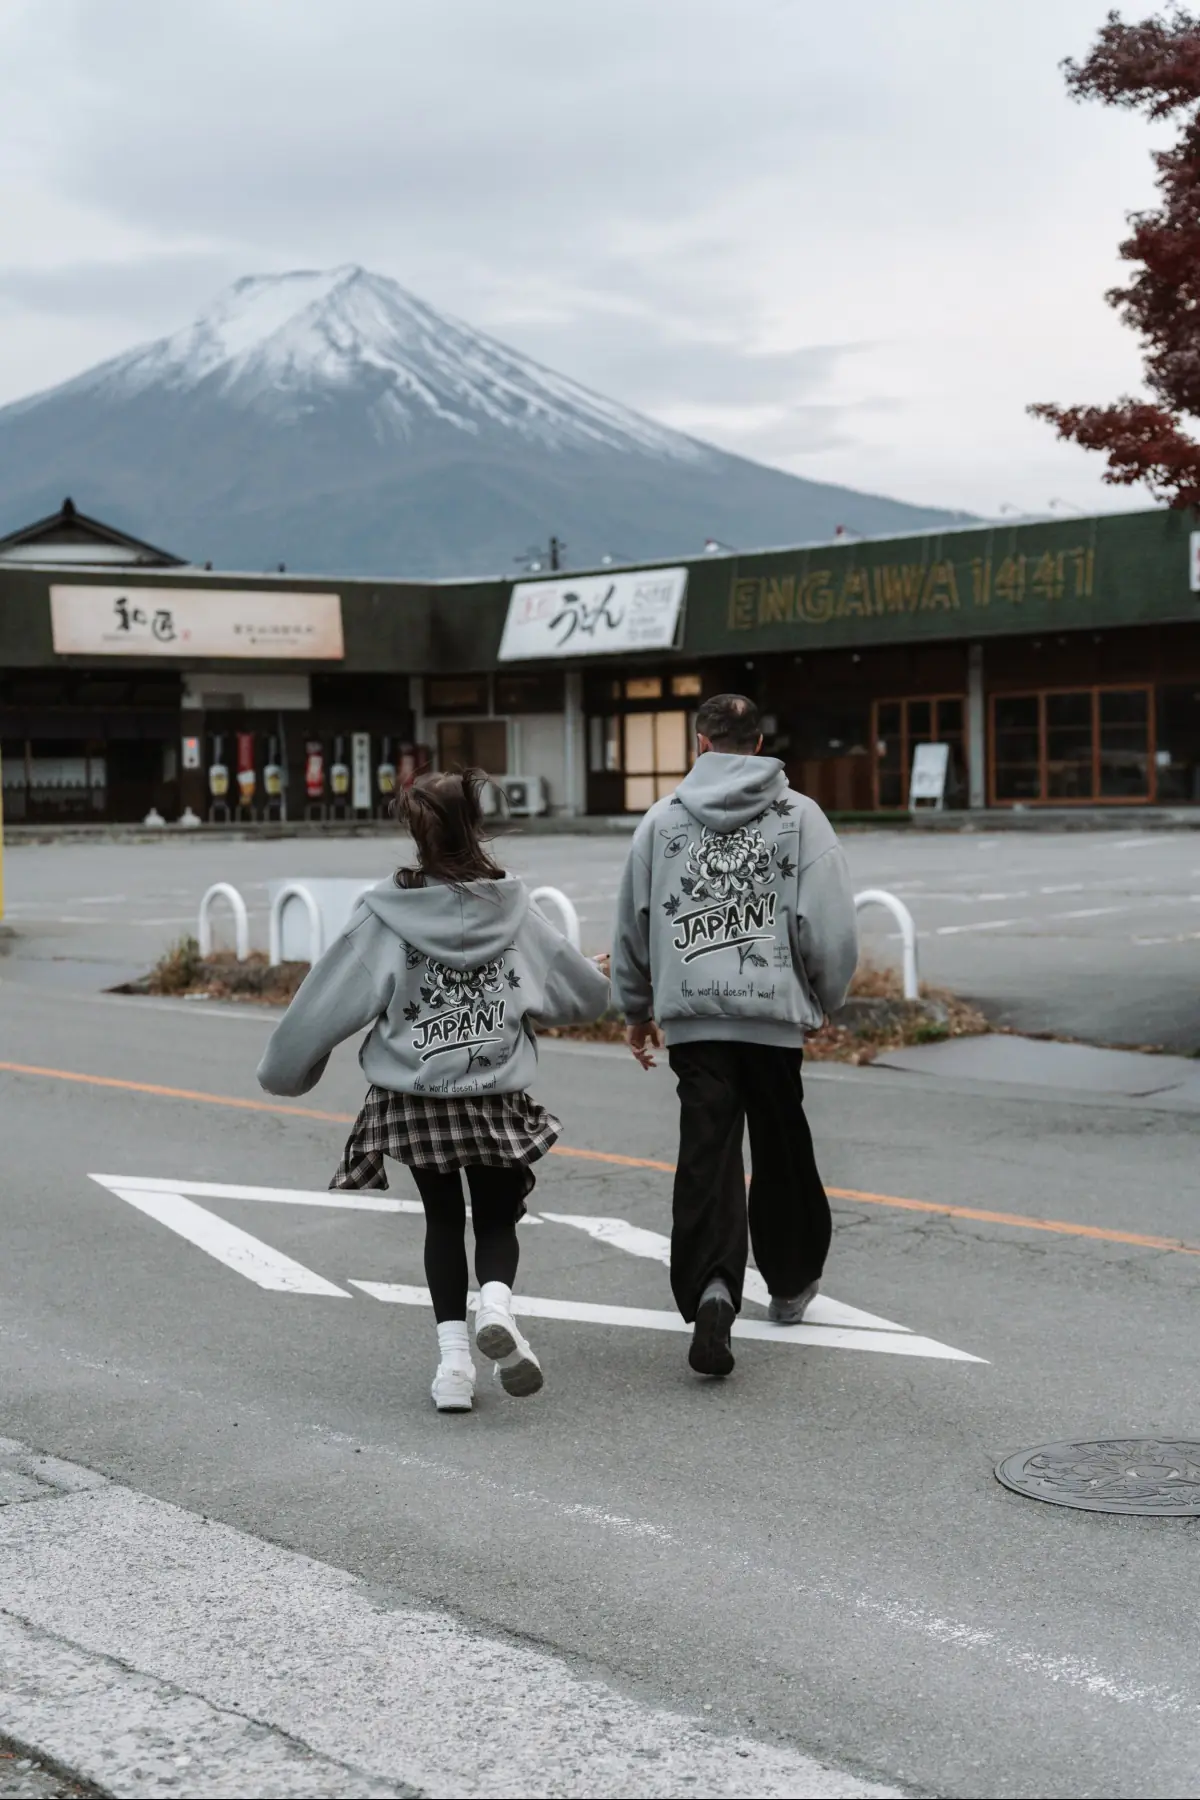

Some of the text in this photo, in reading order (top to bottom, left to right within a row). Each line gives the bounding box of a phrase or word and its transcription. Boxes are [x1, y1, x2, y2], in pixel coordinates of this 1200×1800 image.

[728, 560, 961, 630] ENGAWA
[971, 546, 1096, 606] 1441
[548, 584, 625, 648] うどん
[671, 891, 778, 950] JAPAN!
[681, 979, 775, 1000] the world doesn't wait
[412, 999, 507, 1051] JAPAN!
[413, 1075, 497, 1094] the world doesn't wait
